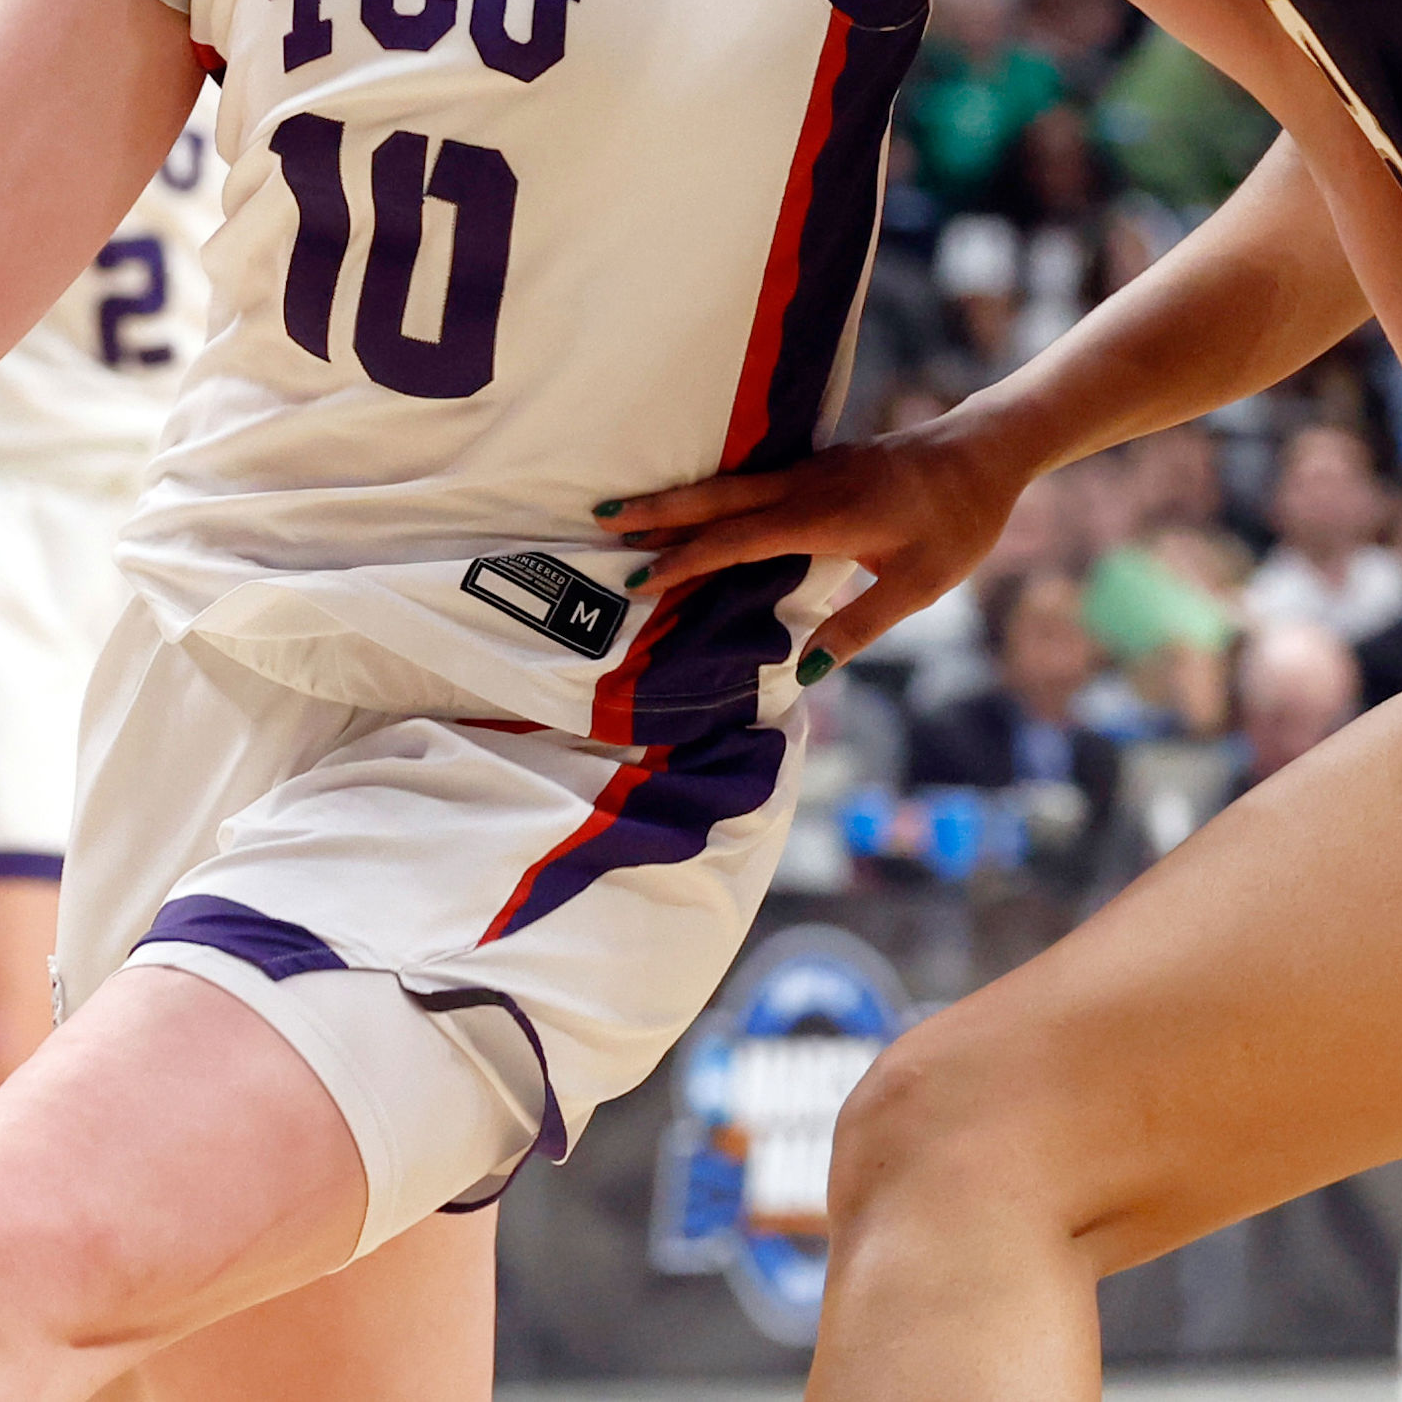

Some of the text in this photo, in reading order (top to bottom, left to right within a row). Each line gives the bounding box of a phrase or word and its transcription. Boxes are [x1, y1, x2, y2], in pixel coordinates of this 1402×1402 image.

[268, 111, 518, 398] 10
[508, 554, 566, 585] INEERED
[569, 600, 601, 633] M
